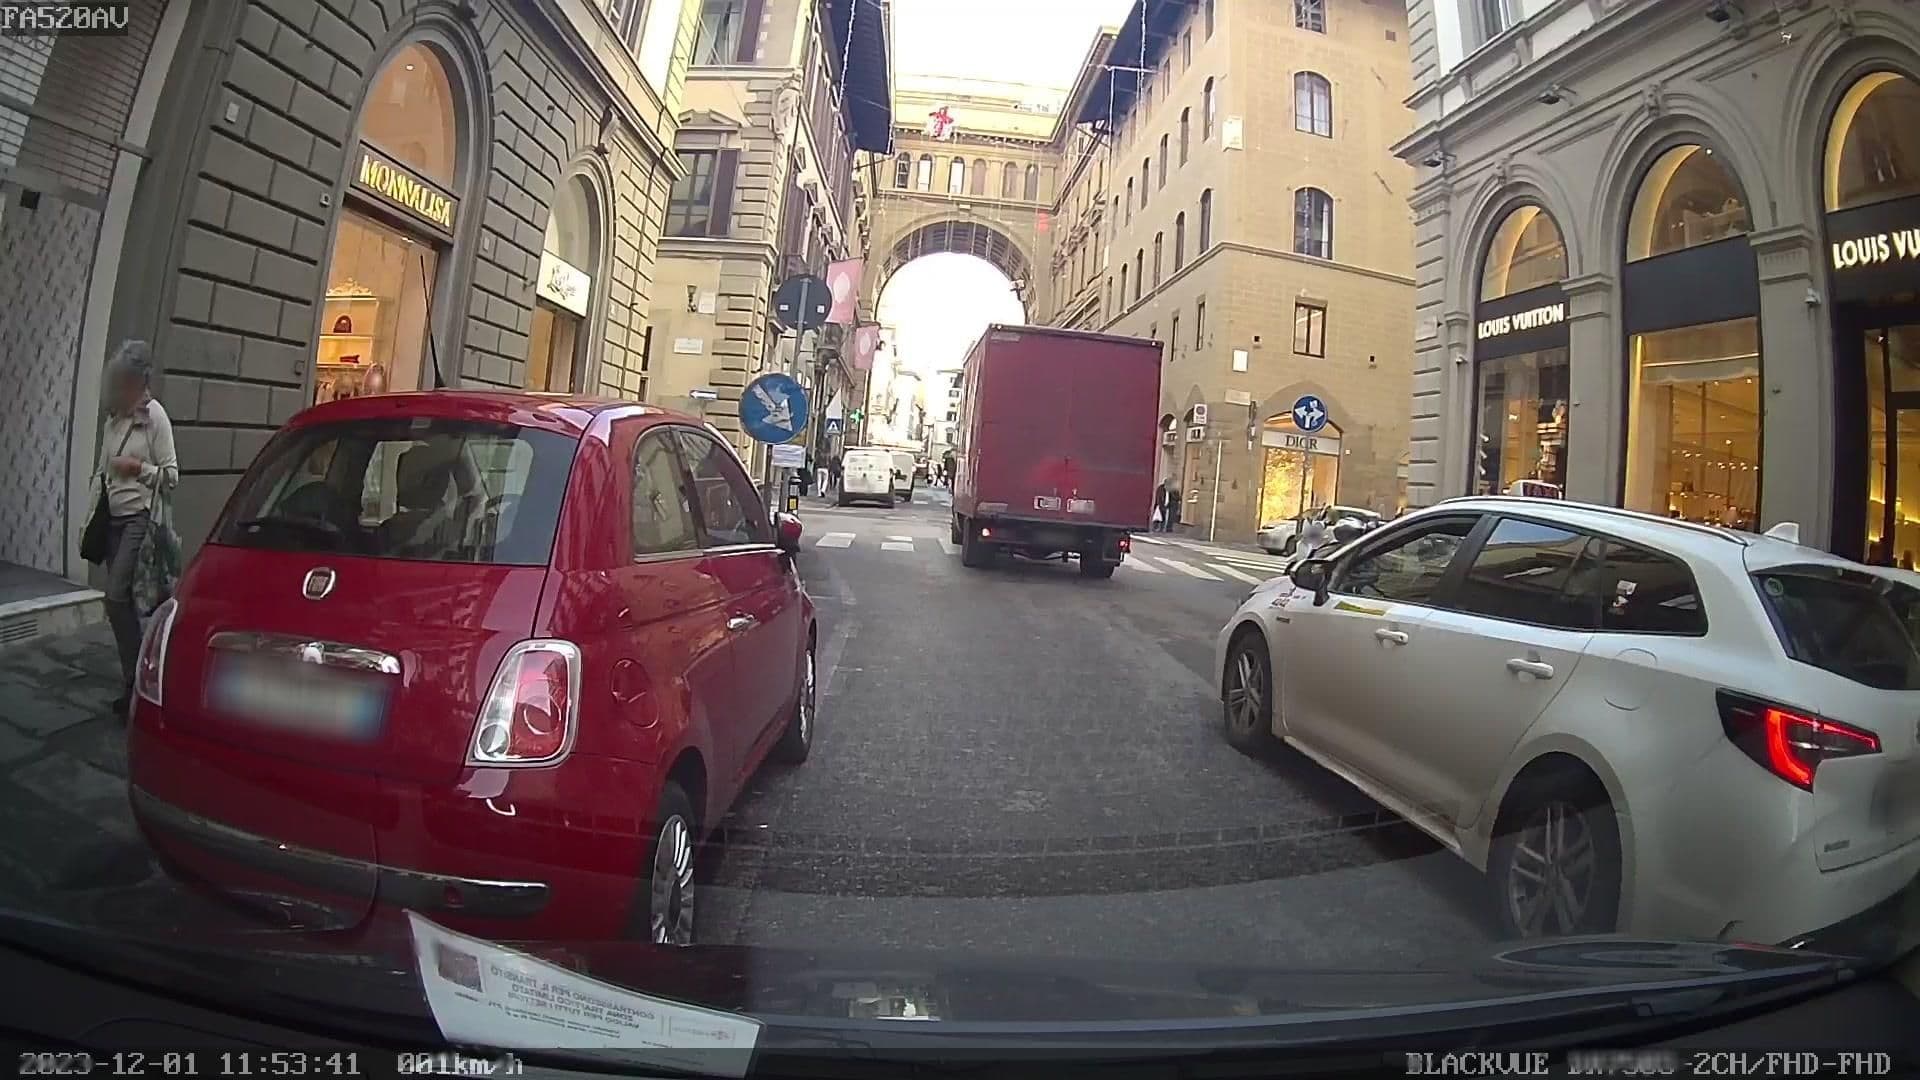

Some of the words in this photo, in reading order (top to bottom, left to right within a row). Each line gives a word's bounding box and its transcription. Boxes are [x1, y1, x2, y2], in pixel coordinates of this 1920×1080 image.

[360, 154, 451, 227] MONNALISA
[1833, 233, 1890, 269] LOUIS
[1478, 316, 1510, 339] LOUIS
[1511, 303, 1564, 330] VUITTON
[1286, 435, 1318, 450] DIOR
